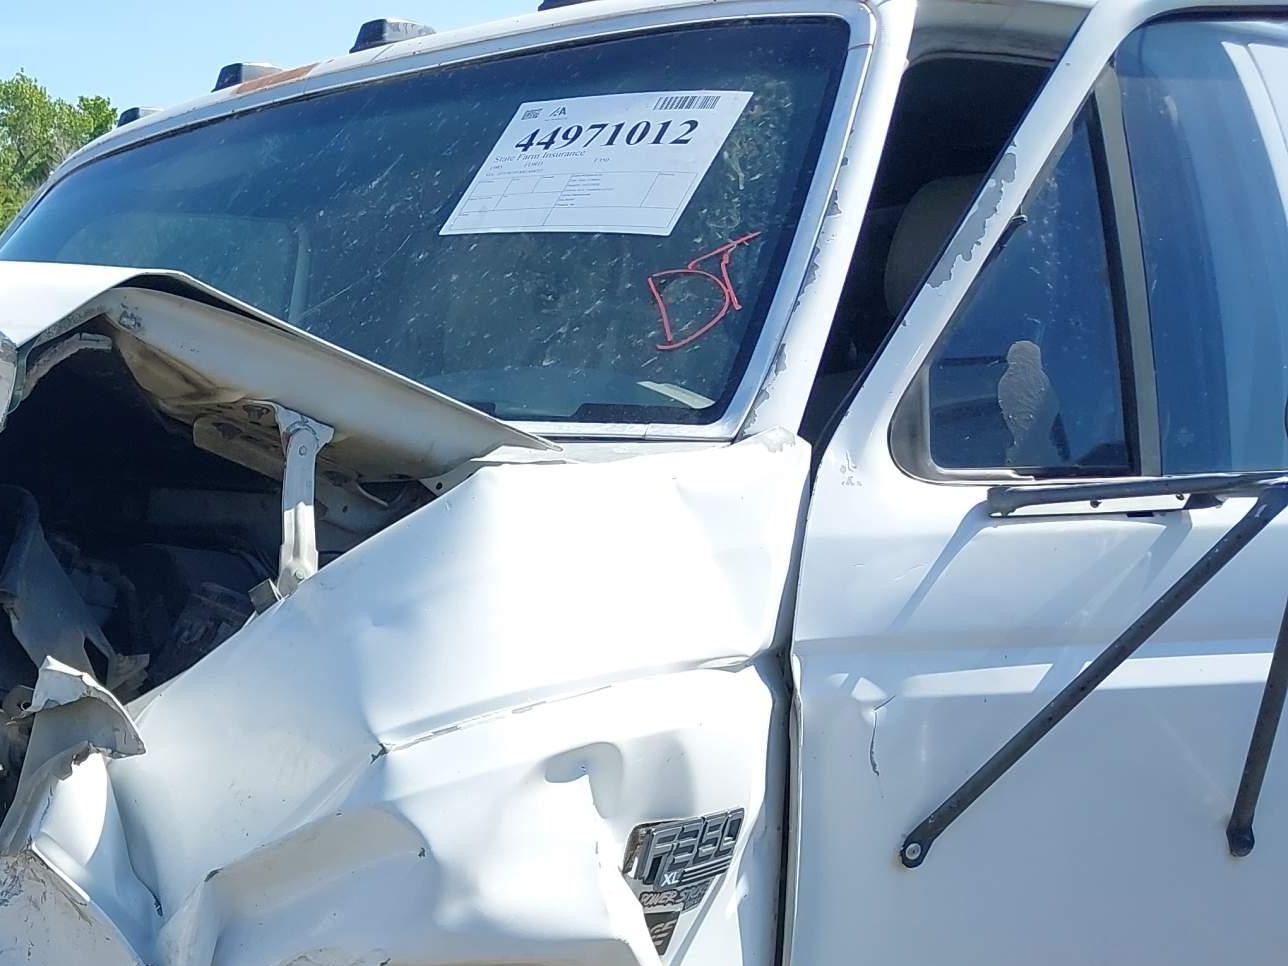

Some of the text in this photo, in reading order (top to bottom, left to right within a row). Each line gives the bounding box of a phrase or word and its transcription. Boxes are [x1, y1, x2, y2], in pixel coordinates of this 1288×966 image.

[515, 119, 700, 153] 44971012
[493, 155, 516, 164] State
[516, 152, 541, 162] Farm
[542, 149, 587, 160] Insurance
[660, 871, 680, 888] XL
[640, 889, 677, 907] POWER
